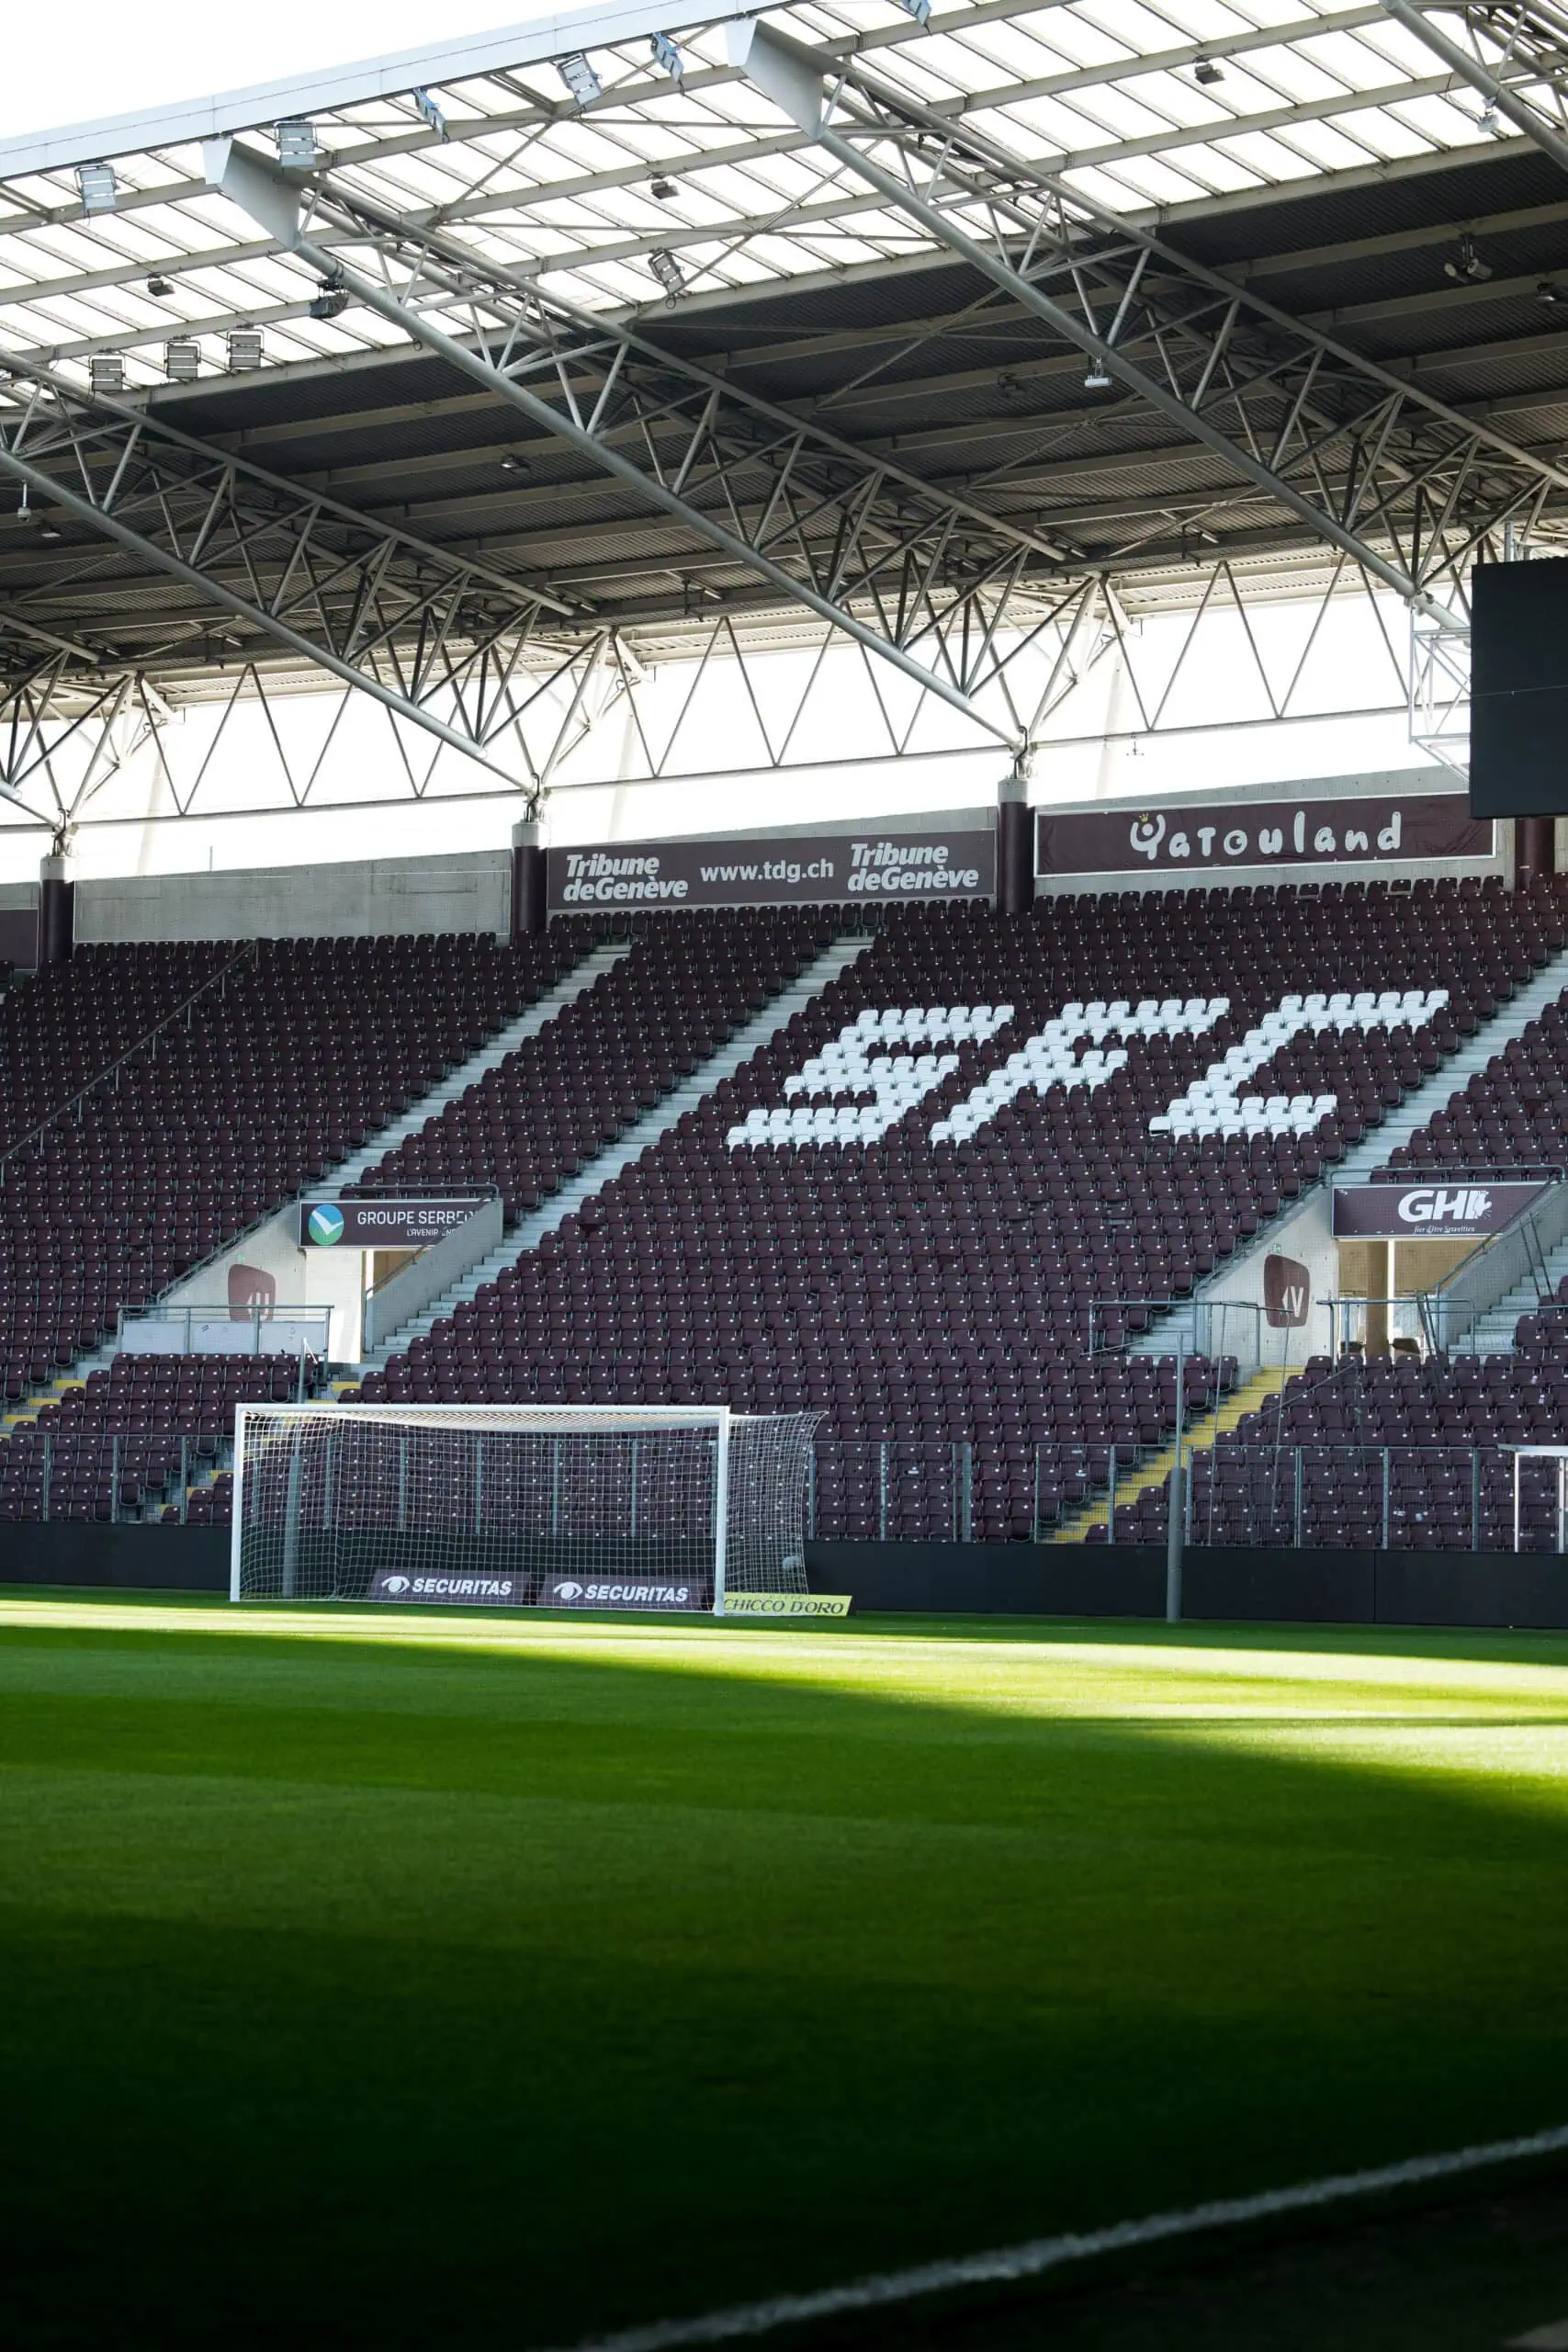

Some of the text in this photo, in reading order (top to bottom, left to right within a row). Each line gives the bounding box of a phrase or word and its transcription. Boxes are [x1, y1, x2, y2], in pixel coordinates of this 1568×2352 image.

[566, 853, 660, 877] Tribune
[851, 842, 949, 867] Tribune
[700, 858, 834, 884] www.tdg.ch
[847, 865, 979, 892] deGenève
[563, 876, 689, 902] deGenève
[356, 1211, 415, 1226] GROUPE
[406, 1227, 439, 1237] L'AVENIR
[412, 1578, 513, 1596] SECURITAS
[584, 1584, 689, 1602] SECURITAS
[723, 1599, 844, 1614] CHICCO D'ORO
